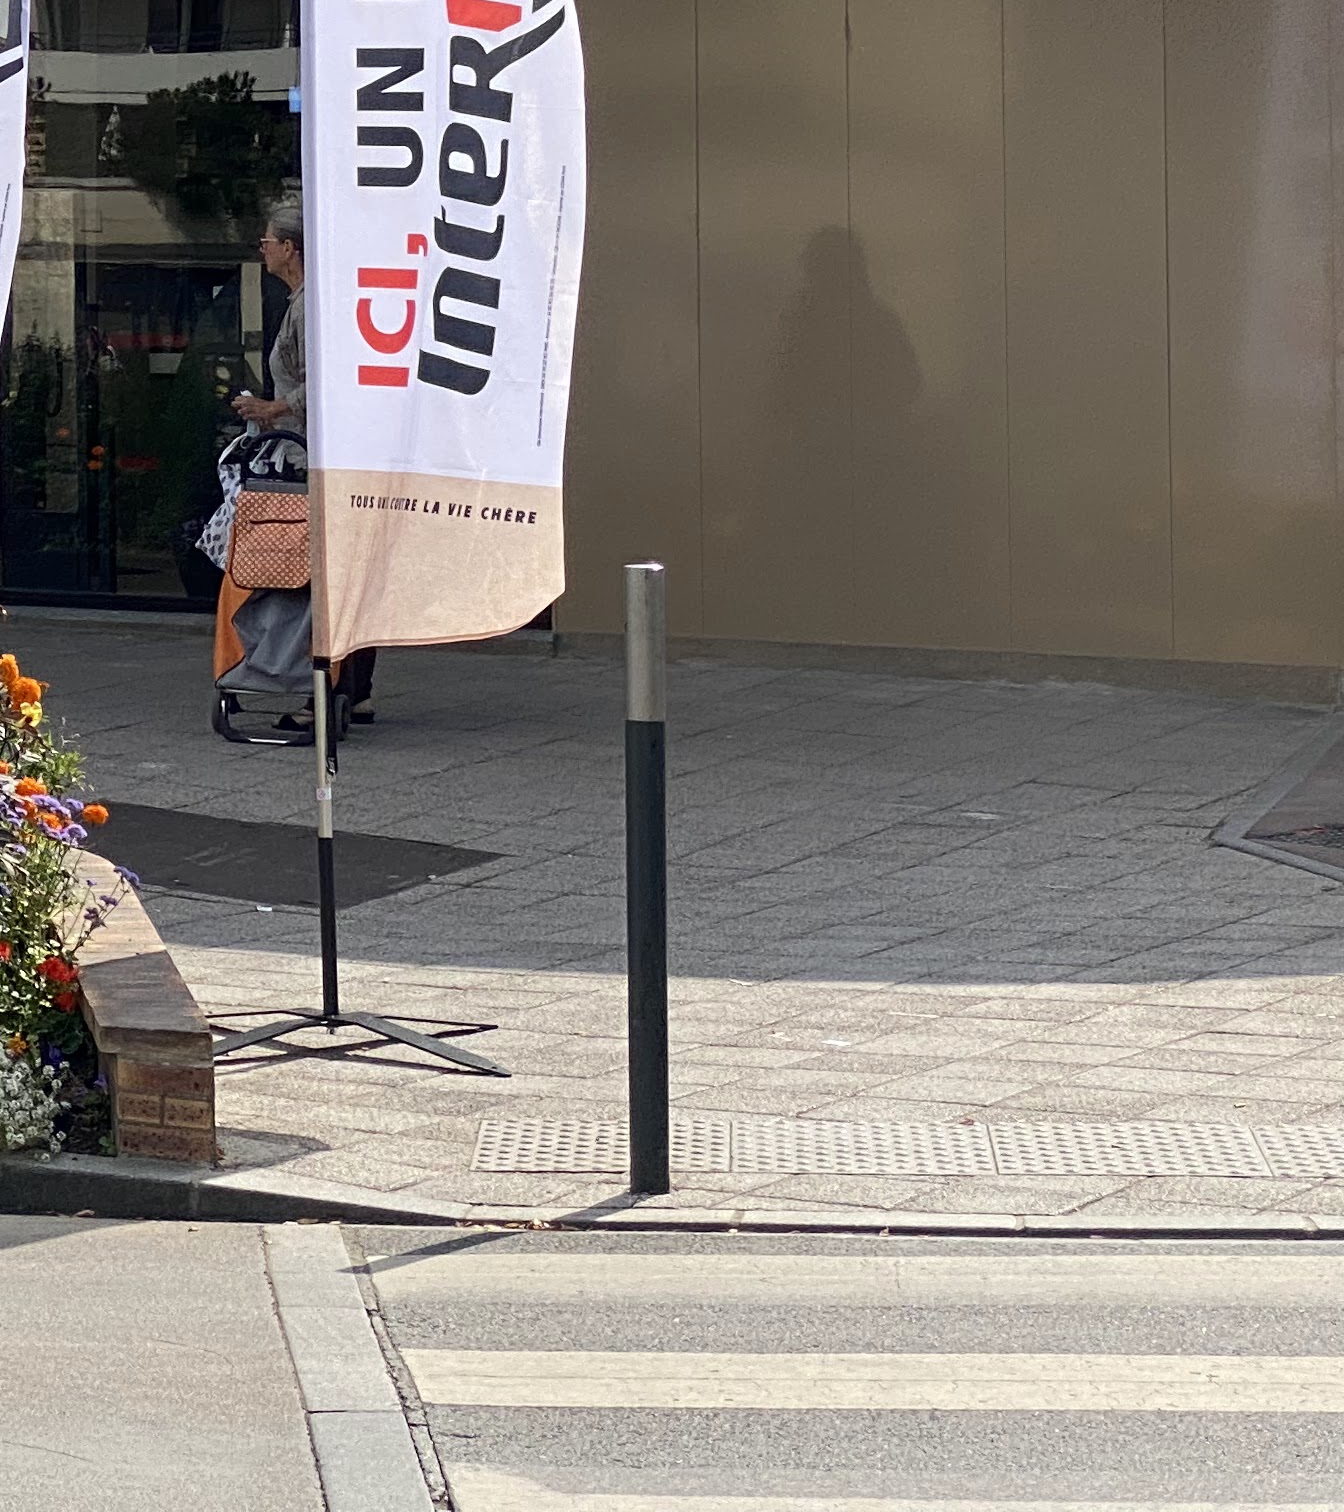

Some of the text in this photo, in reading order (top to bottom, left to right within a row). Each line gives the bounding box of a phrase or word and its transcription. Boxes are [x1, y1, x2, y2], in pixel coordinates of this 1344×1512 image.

[356, 48, 426, 188] UN
[356, 233, 429, 388] ICI,
[350, 495, 375, 509] TOUS
[423, 500, 441, 515] LA
[448, 503, 473, 519] VIE
